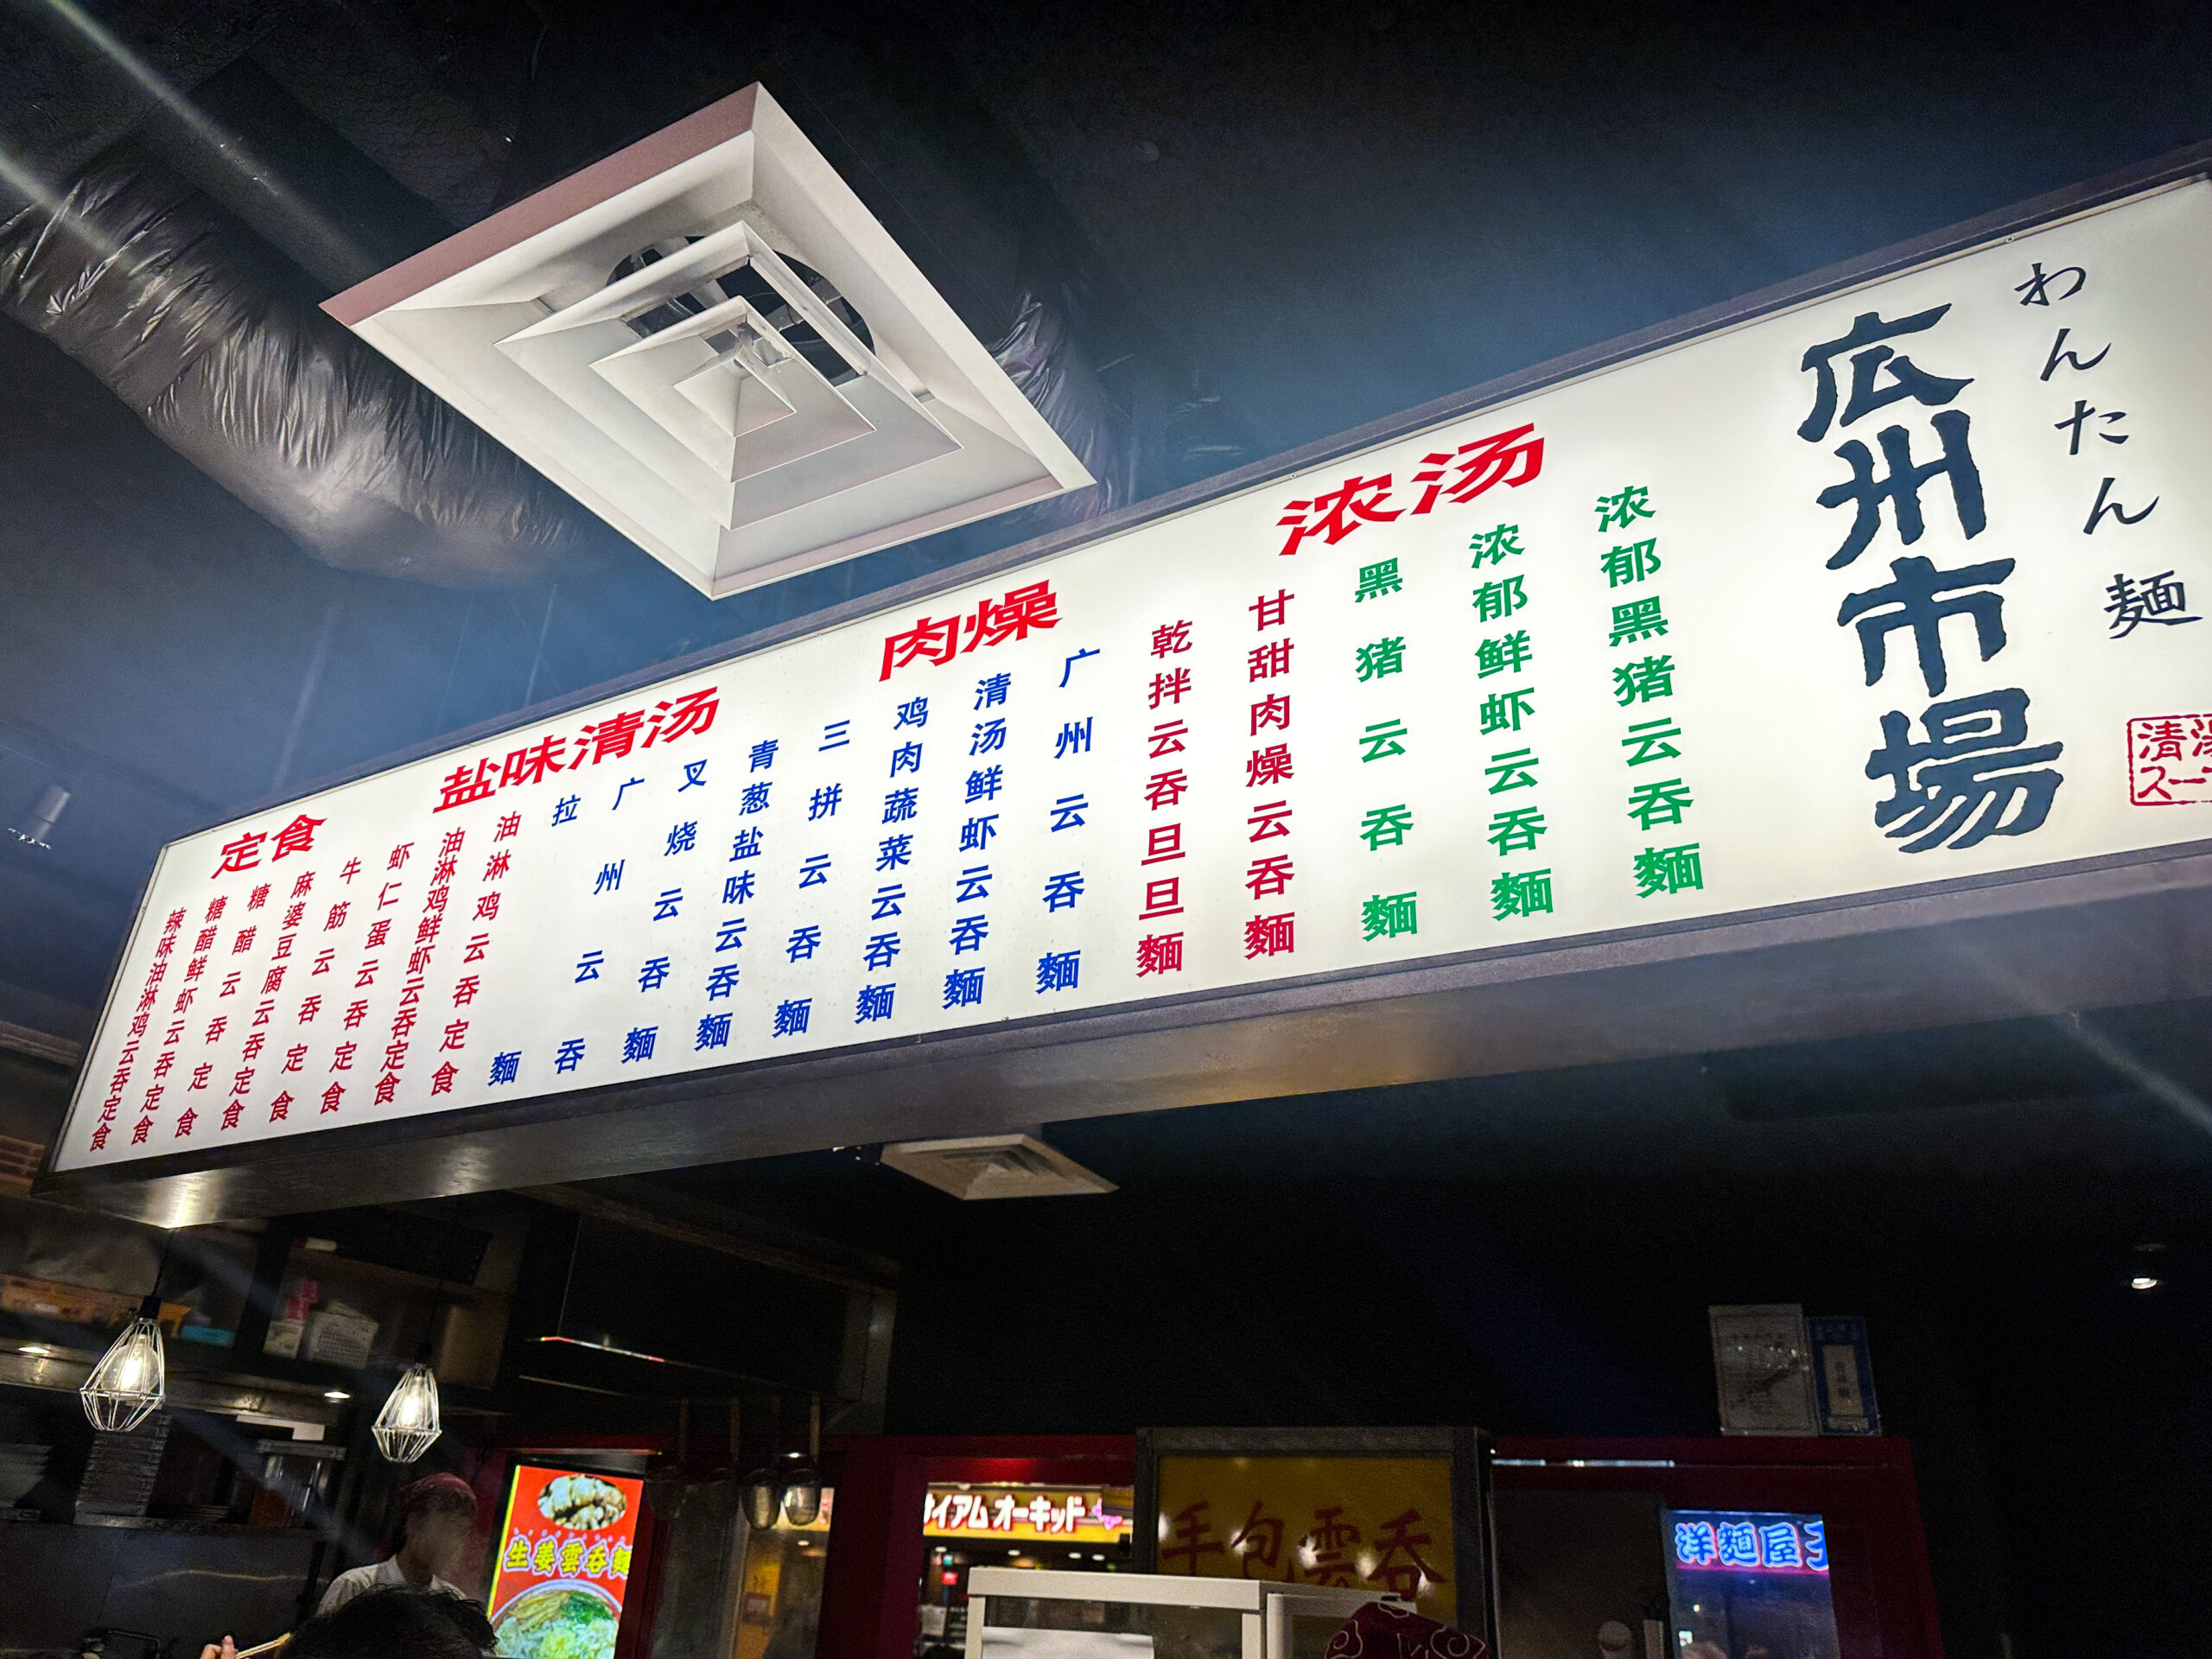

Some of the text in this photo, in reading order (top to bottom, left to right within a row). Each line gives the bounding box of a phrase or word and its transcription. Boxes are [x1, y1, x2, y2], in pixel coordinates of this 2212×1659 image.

[1276, 423, 1545, 556] 浓汤
[2013, 262, 2203, 640] わんたん麺
[879, 580, 1061, 683] 肉燥
[1796, 302, 2063, 854] 広州市場
[432, 686, 720, 814] 盐味清汤
[2137, 766, 2212, 800] スー
[211, 814, 327, 880] 定食
